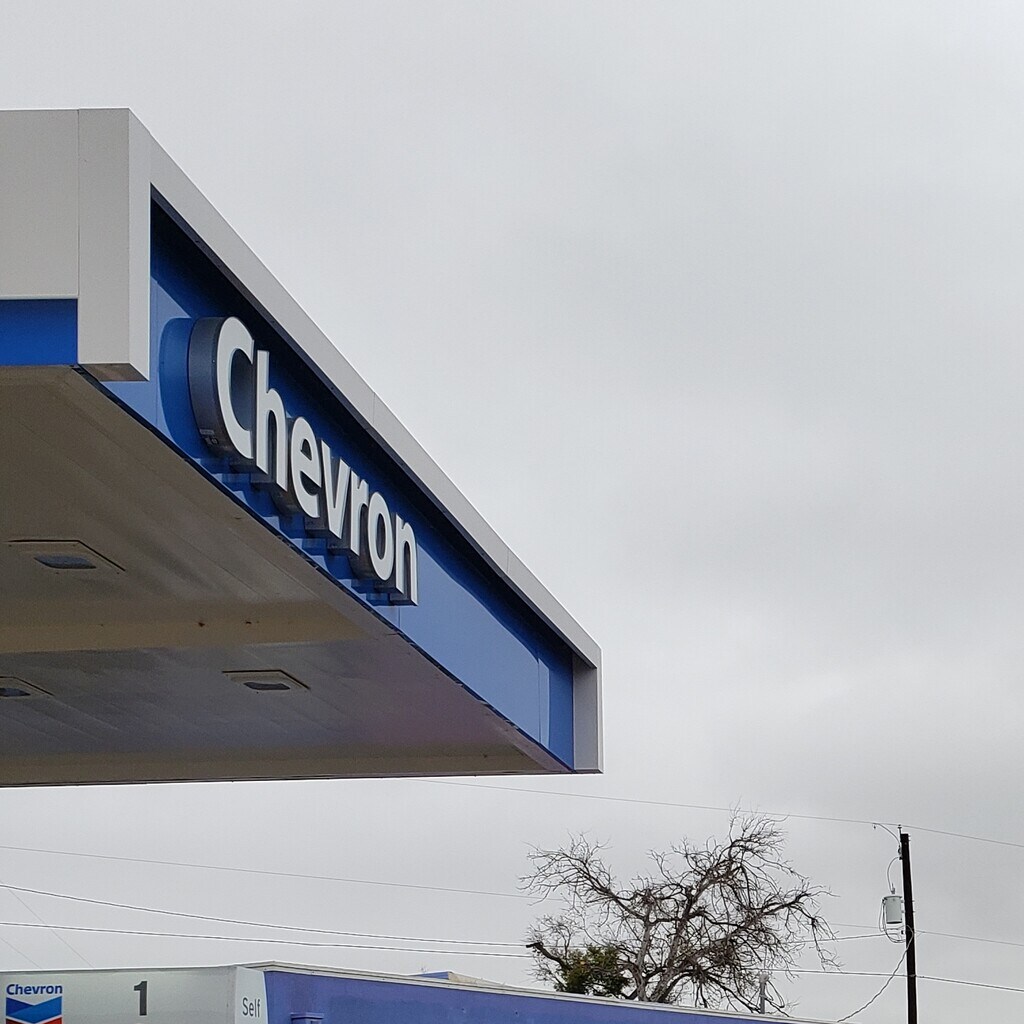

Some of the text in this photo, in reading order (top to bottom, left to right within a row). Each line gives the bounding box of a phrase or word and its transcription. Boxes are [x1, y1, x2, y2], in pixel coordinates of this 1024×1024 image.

[214, 315, 419, 607] Chevron
[6, 983, 63, 995] Chevron
[133, 980, 148, 1016] 1
[242, 996, 260, 1018] Self
